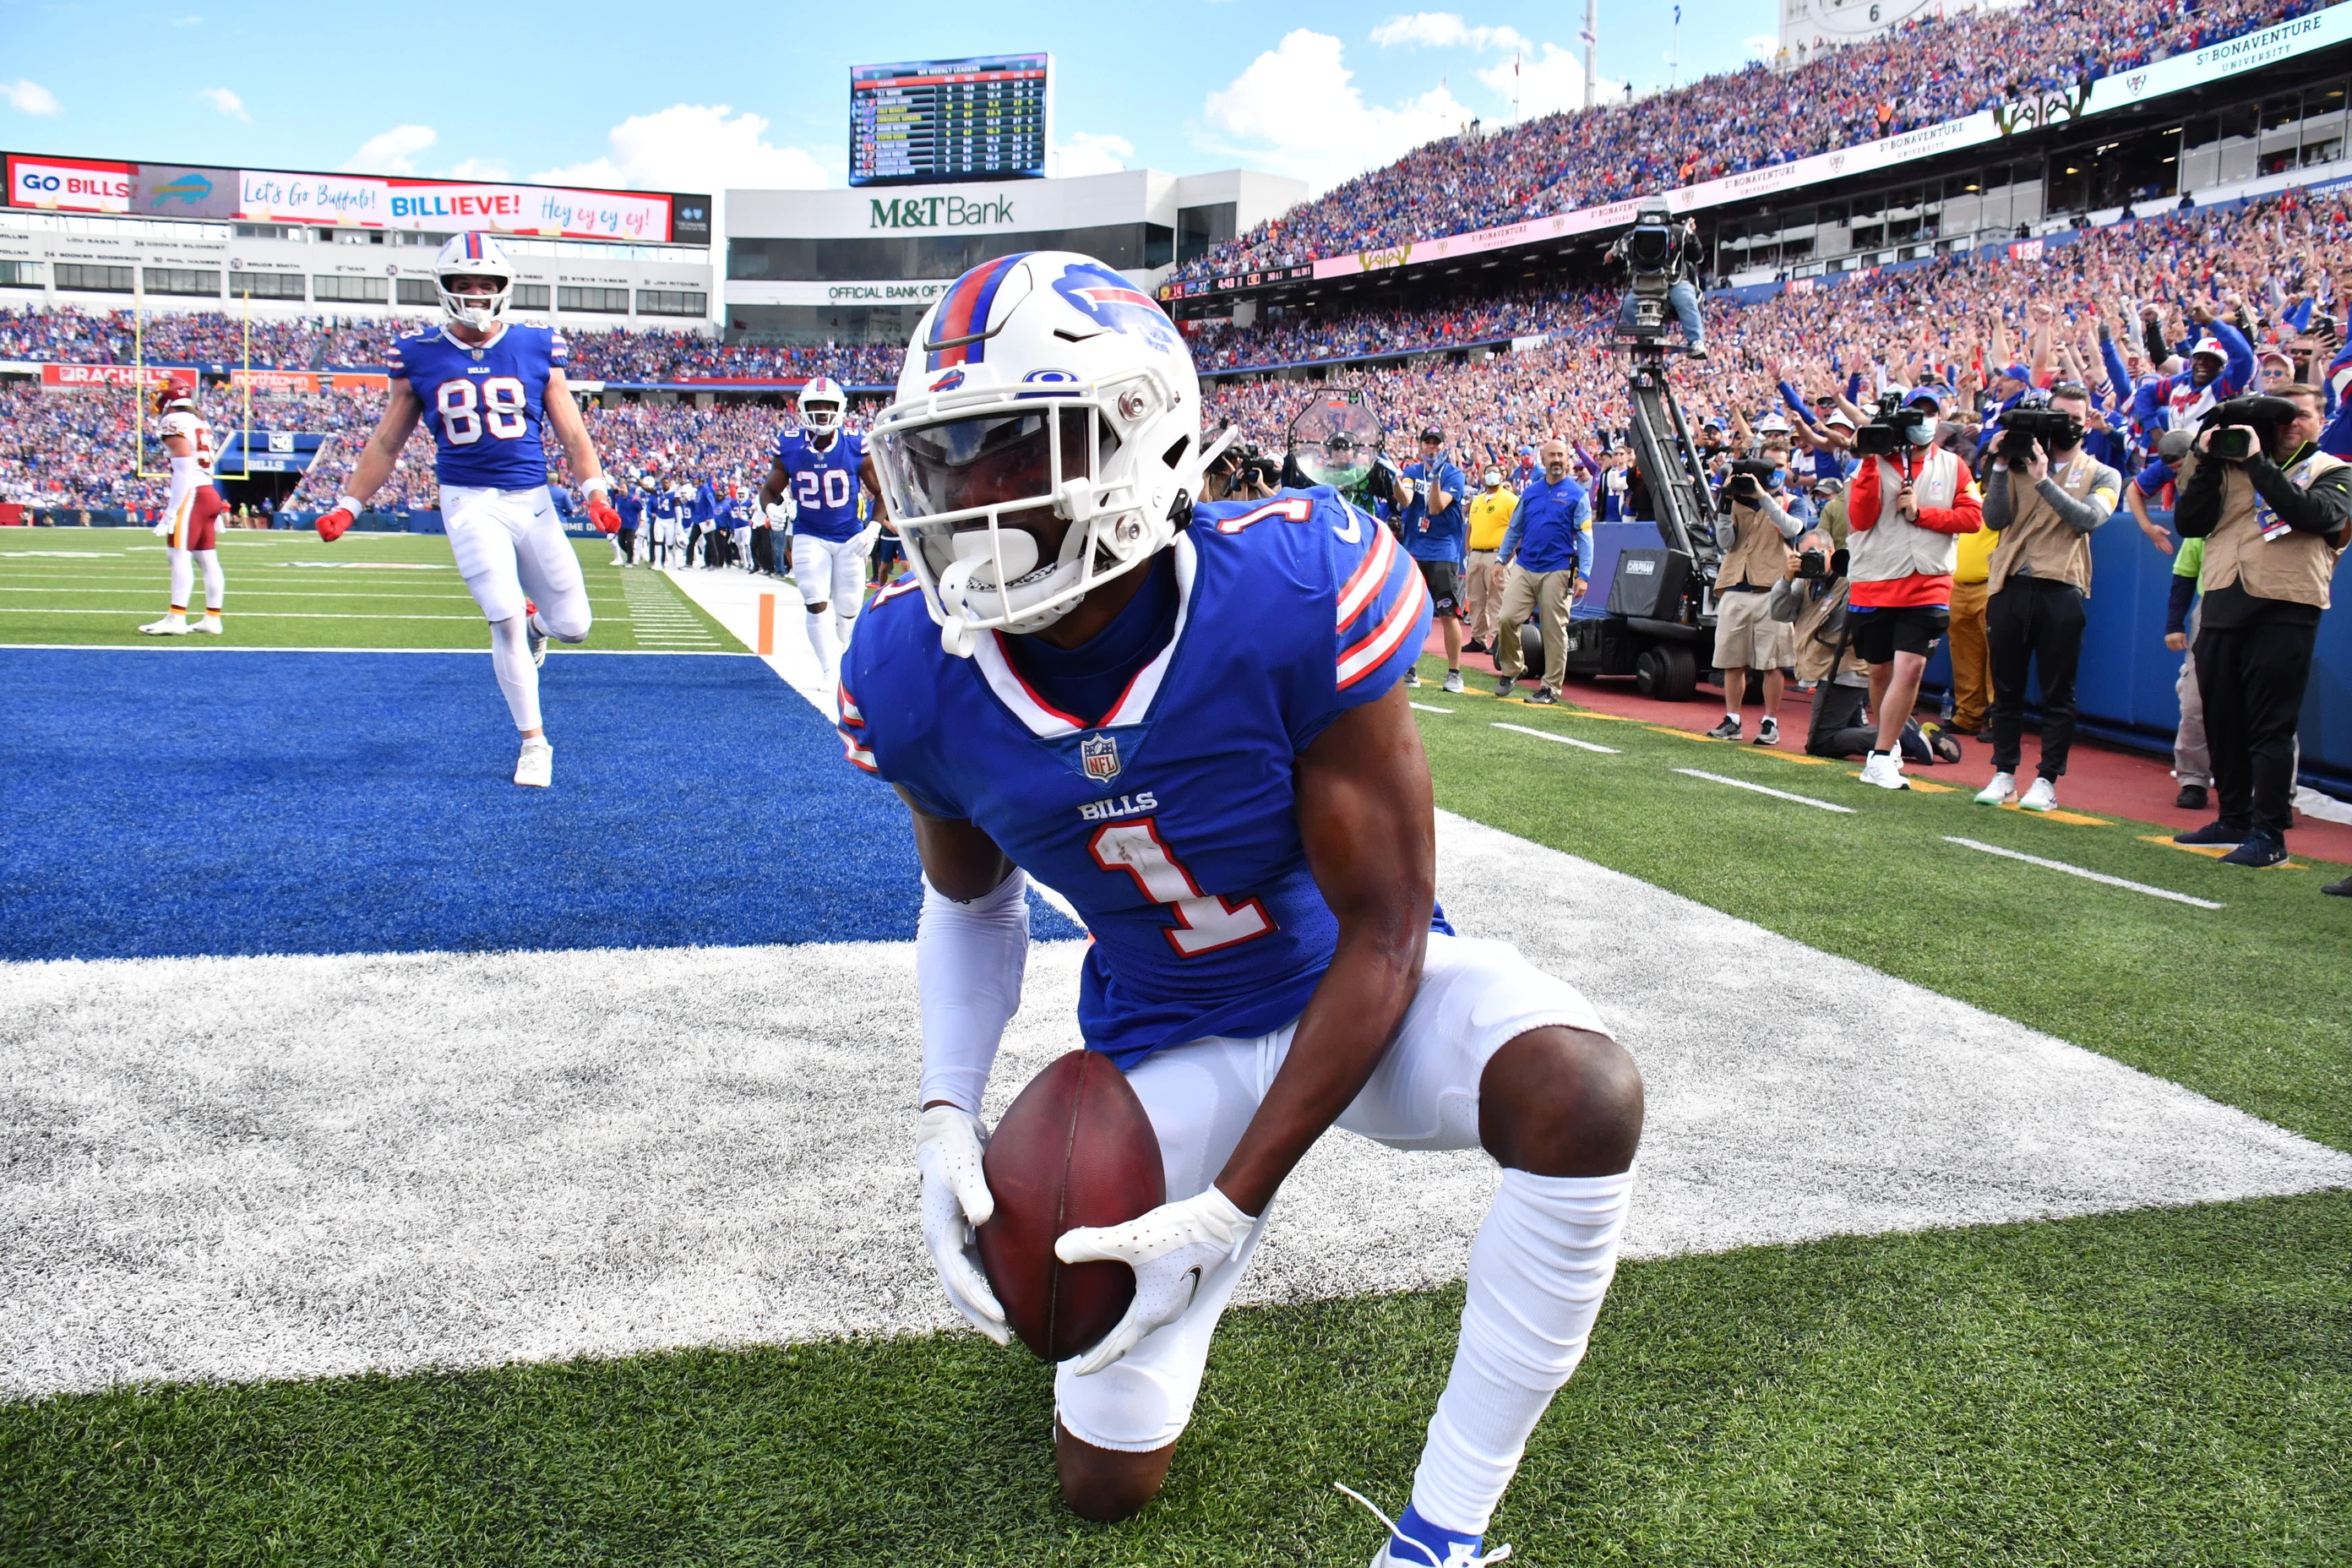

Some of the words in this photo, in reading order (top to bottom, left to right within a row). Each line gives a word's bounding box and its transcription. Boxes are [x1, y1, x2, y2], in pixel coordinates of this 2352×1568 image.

[1870, 5, 1879, 22] 6
[2212, 16, 2322, 62] BONAVENTURE
[954, 65, 980, 74] LEADERS
[2222, 45, 2291, 72] UNIVERSITY
[1891, 122, 1964, 150] BONAVENTURE
[1897, 142, 1944, 158] UNIVERSITY
[22, 174, 60, 191] GO
[67, 177, 138, 199] BILLS!
[1734, 165, 1796, 188] BONAVENTURE
[244, 177, 282, 204] Let's
[288, 182, 309, 206] Go
[317, 183, 376, 210] Buffalo!
[390, 194, 520, 217] BILLIEVE!
[542, 195, 571, 227] Hey
[578, 207, 596, 230] ey
[600, 209, 618, 232] ey
[626, 208, 649, 235] ey!
[869, 196, 945, 228] M&T
[947, 193, 1014, 226] Bank
[1479, 225, 1527, 241] BONAVENTURE
[829, 286, 882, 299] OFFICIAL
[886, 286, 919, 297] BANK
[922, 285, 938, 297] OF
[1173, 286, 1182, 296] 14
[1198, 282, 1206, 292] 27
[1217, 278, 1234, 290] 4:43
[74, 367, 174, 384] RACHEL'S
[437, 376, 528, 446] 88
[248, 460, 286, 471] BILLS
[797, 469, 850, 510] 20
[657, 497, 670, 511] 14
[1216, 496, 1313, 535] 1
[1626, 561, 1654, 574] CHAPMAN
[1088, 755, 1115, 774] NFL
[1077, 792, 1158, 821] BILLS
[1086, 816, 1280, 959] 1
